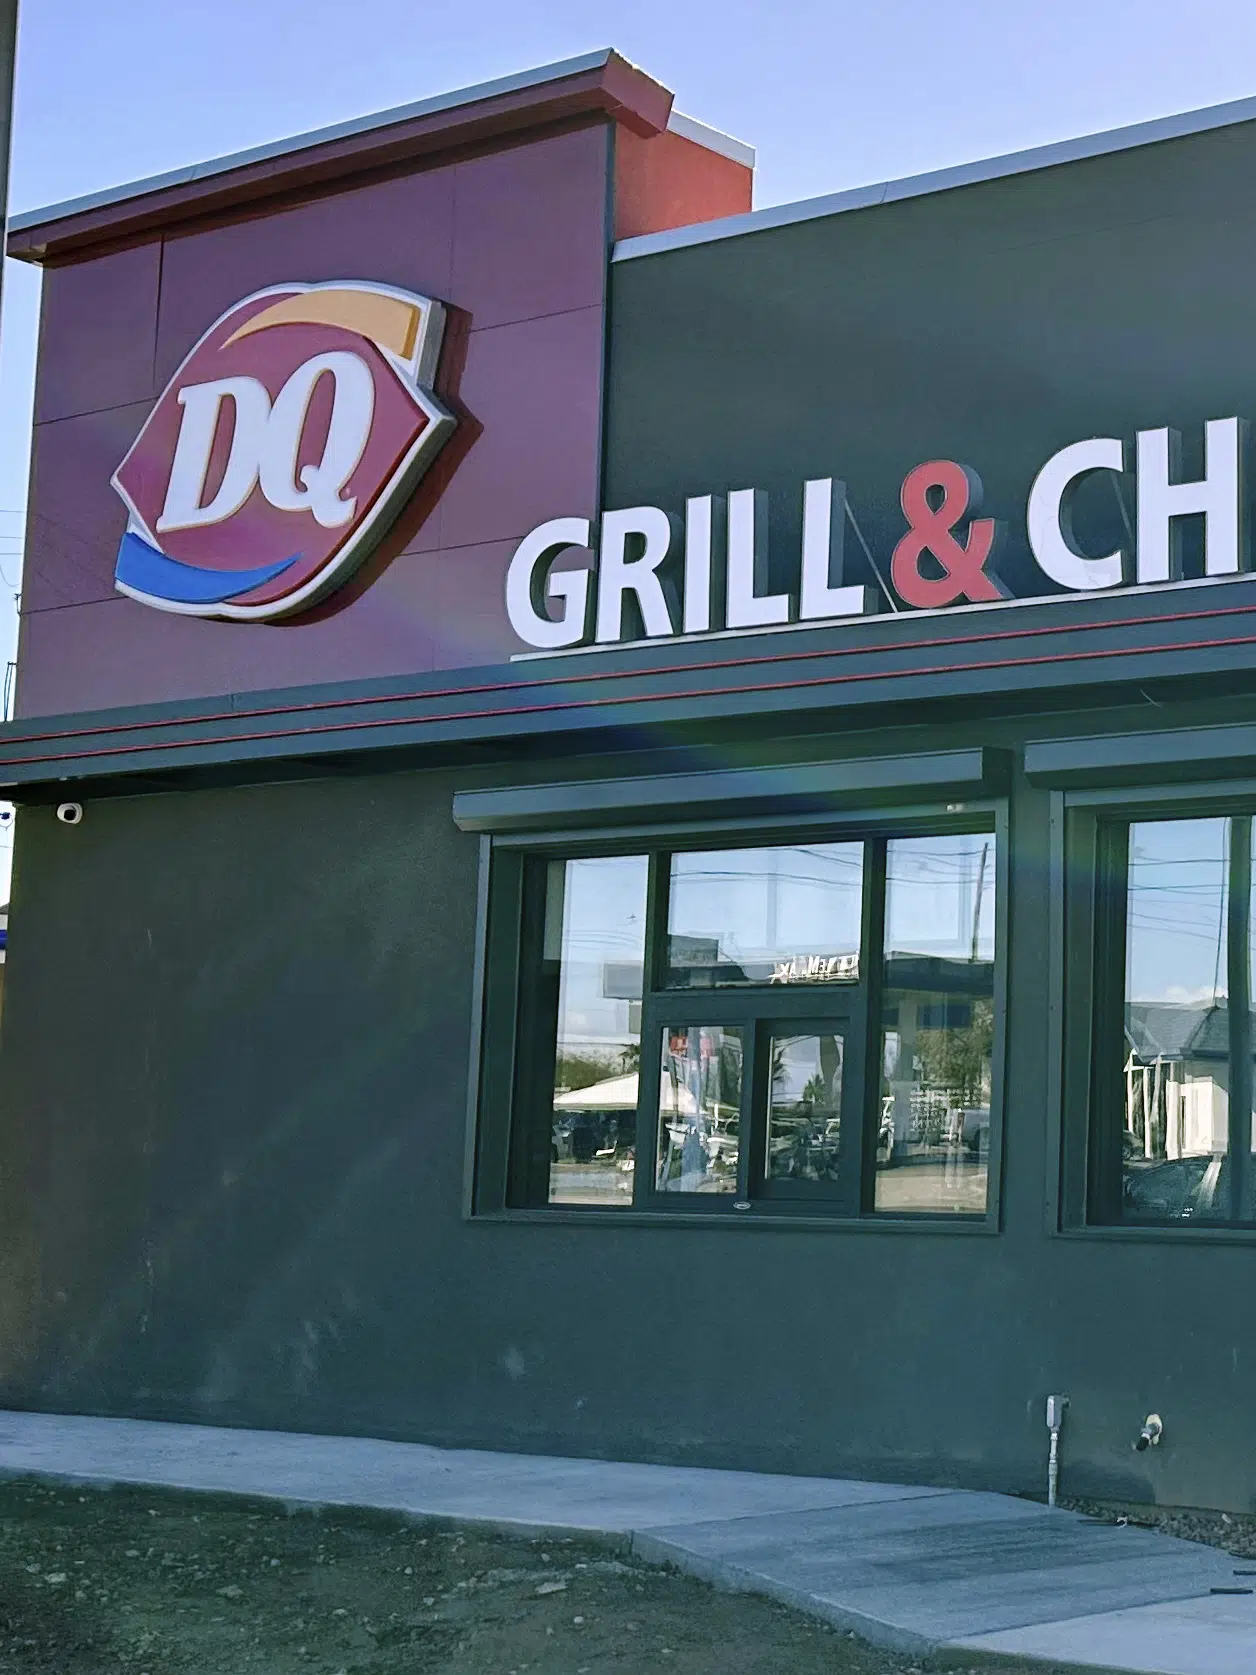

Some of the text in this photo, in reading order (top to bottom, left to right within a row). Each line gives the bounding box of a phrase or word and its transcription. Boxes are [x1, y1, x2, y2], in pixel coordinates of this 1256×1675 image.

[156, 350, 359, 533] DQ
[506, 478, 866, 649] GRILL
[891, 459, 1005, 608] &
